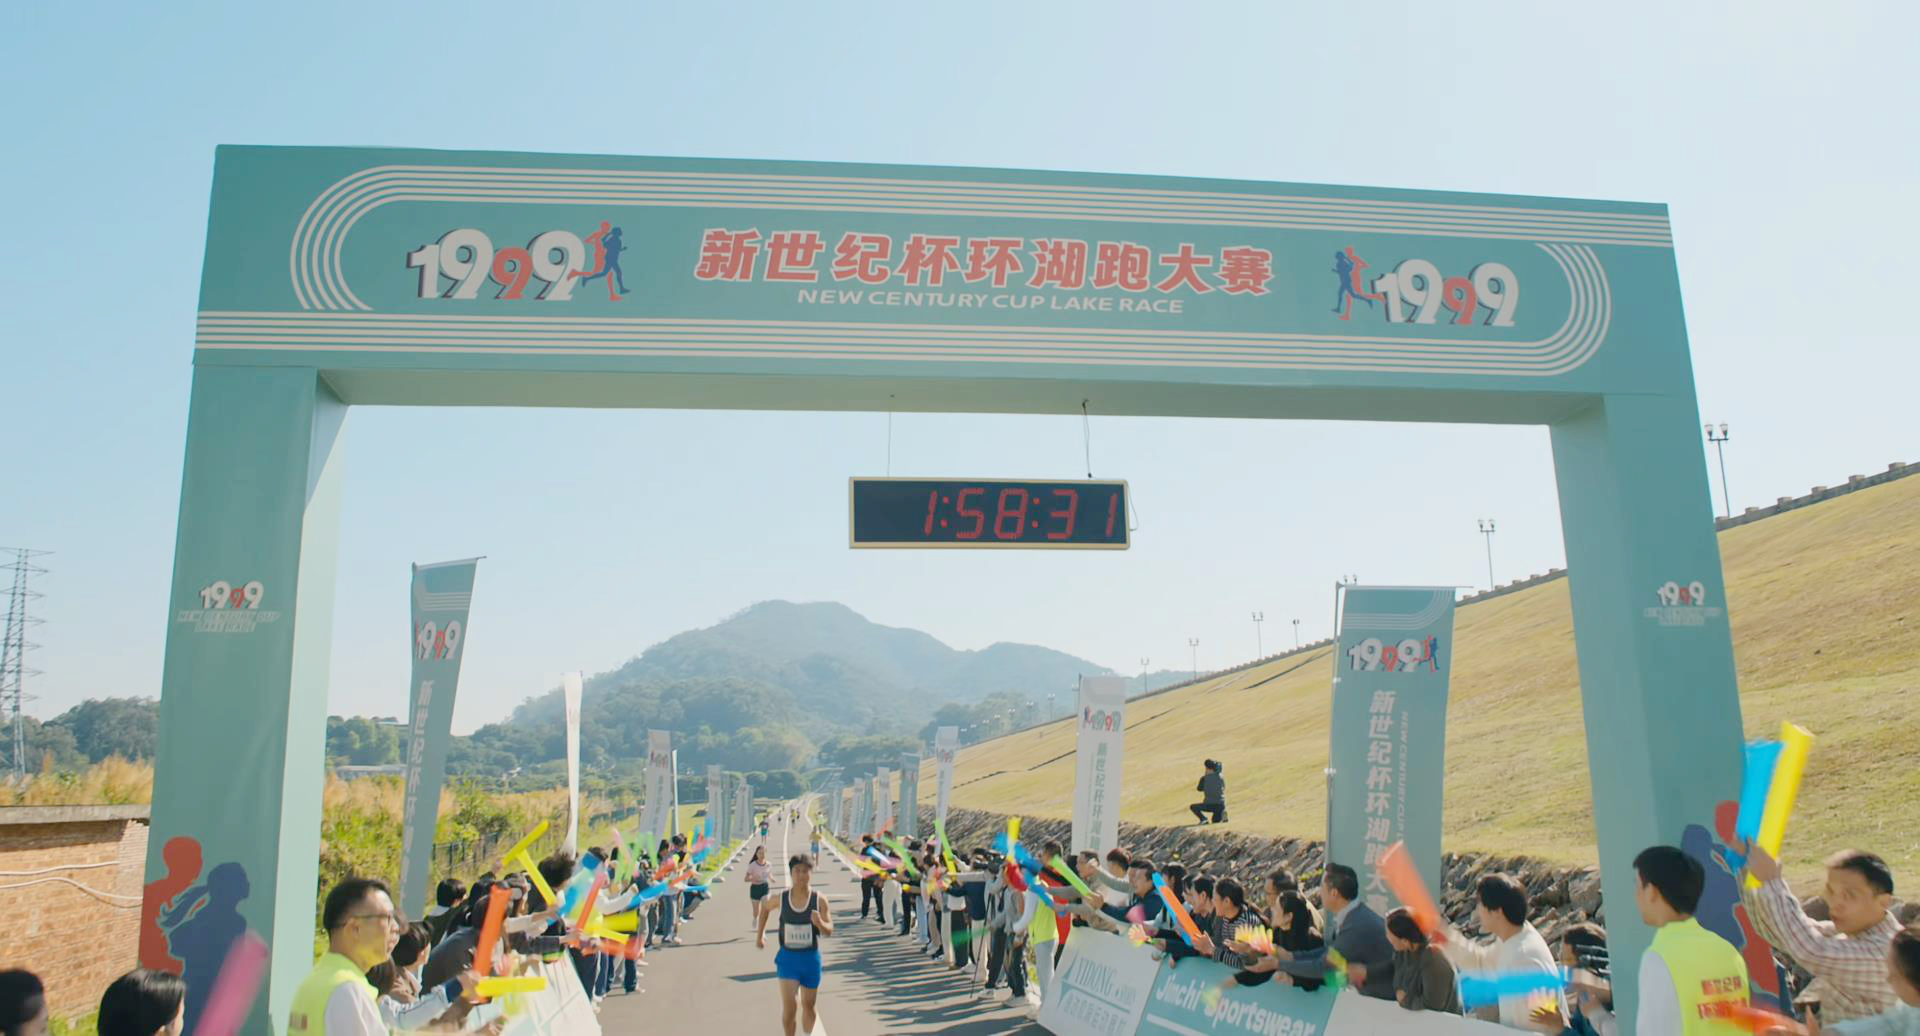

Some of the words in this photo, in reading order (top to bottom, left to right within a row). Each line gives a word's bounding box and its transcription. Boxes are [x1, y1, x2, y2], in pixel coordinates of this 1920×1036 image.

[406, 228, 586, 301] 1999
[694, 228, 1275, 297] 新世纪杯环湖跑大赛
[797, 289, 864, 305] NEW
[867, 291, 989, 308] CENTURY
[992, 294, 1046, 310] CUP
[1051, 295, 1113, 312] LAKE
[1119, 297, 1185, 314] RACE
[1370, 258, 1520, 328] 1999
[199, 580, 265, 609] 1999
[1347, 637, 1422, 672] 1999
